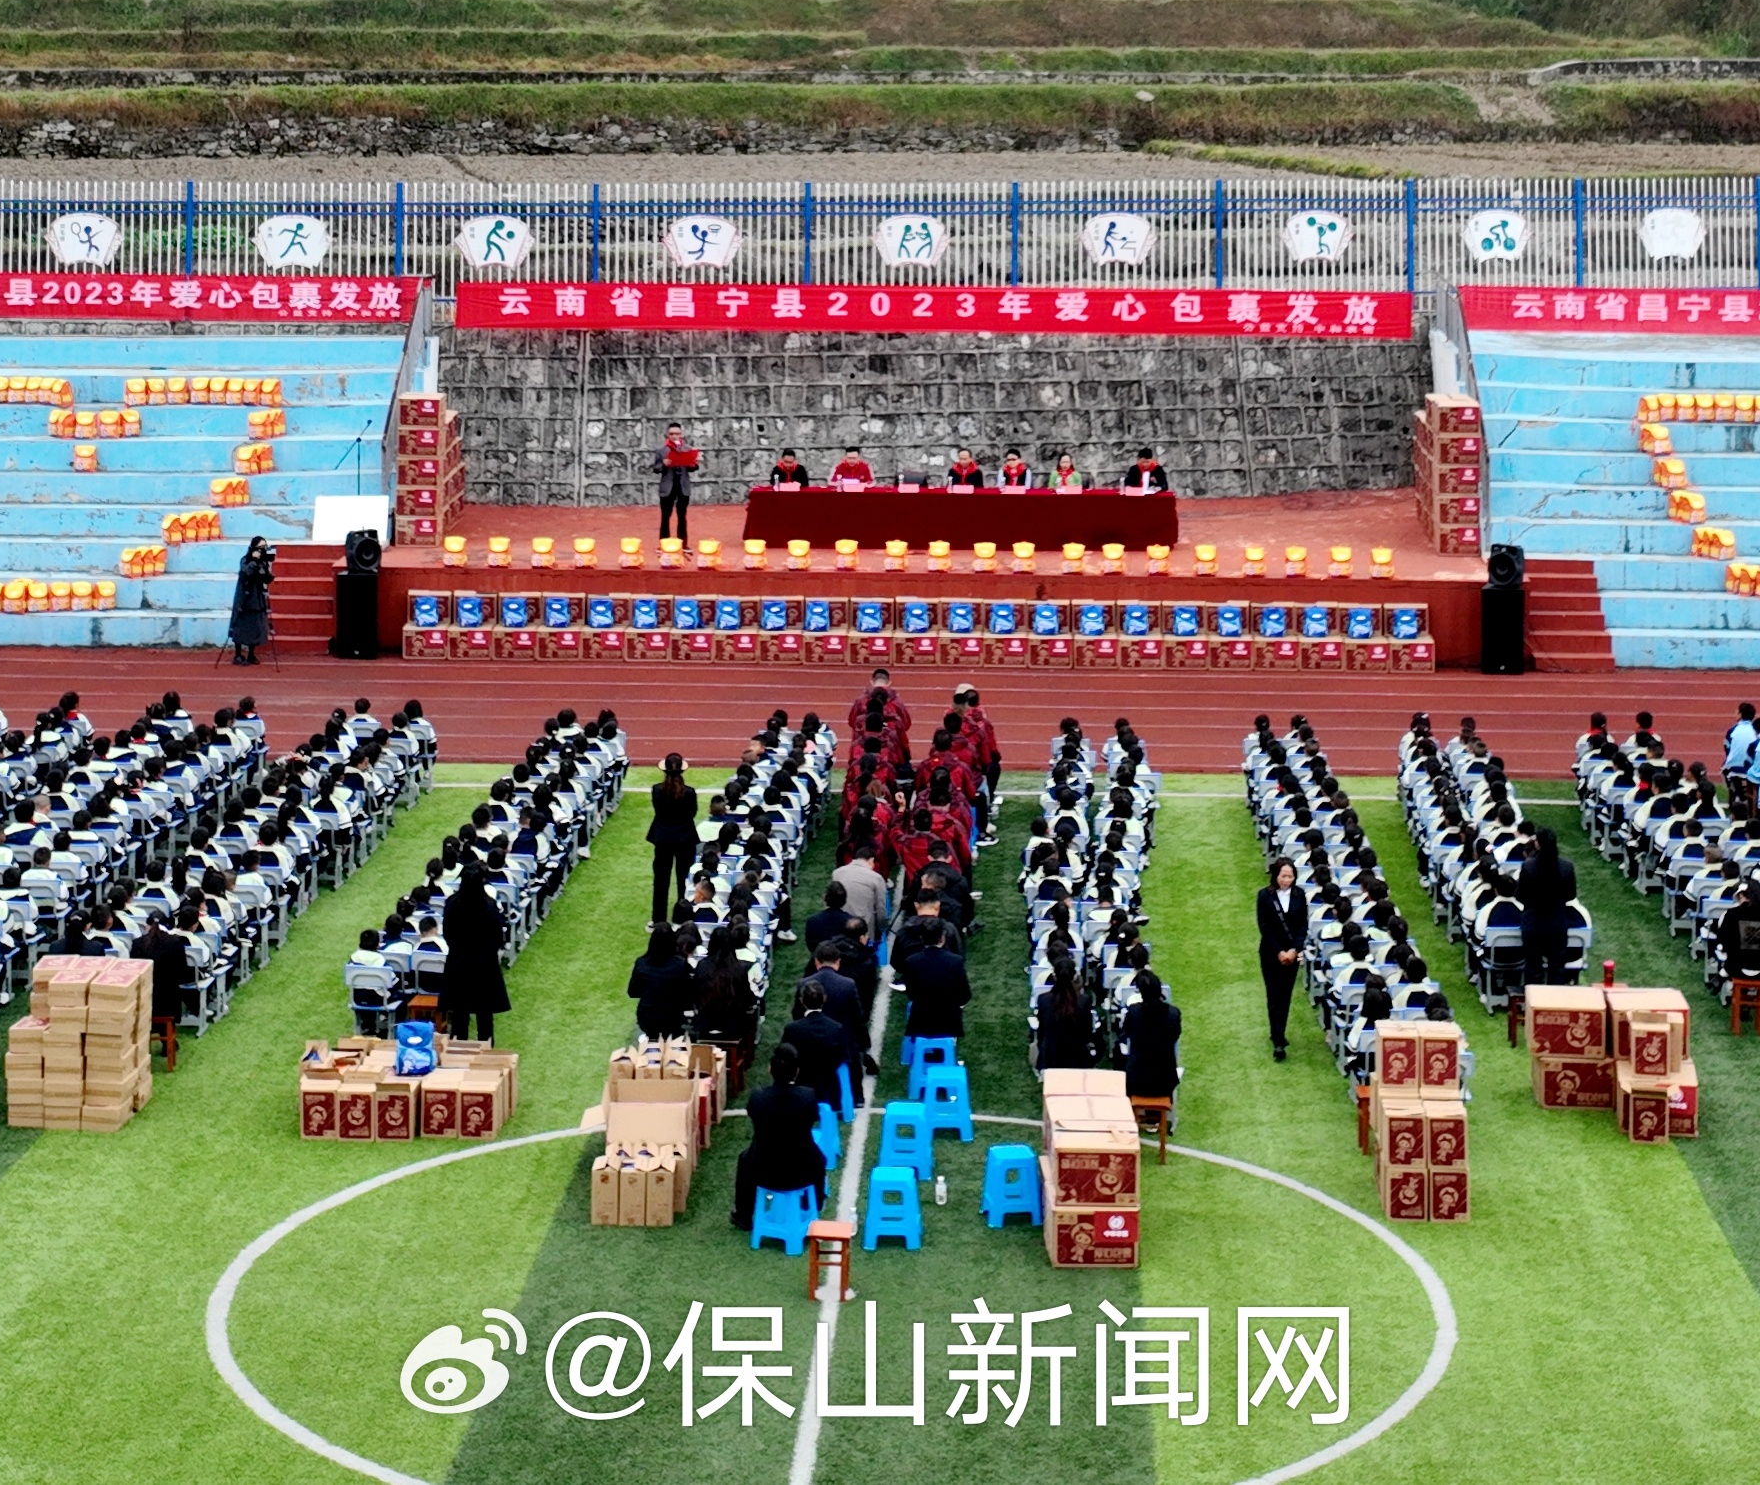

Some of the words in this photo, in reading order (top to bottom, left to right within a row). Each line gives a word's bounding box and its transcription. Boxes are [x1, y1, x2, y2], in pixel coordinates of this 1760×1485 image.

[499, 287, 1378, 325] 云南省昌宁县2023年爱心包裹发放
